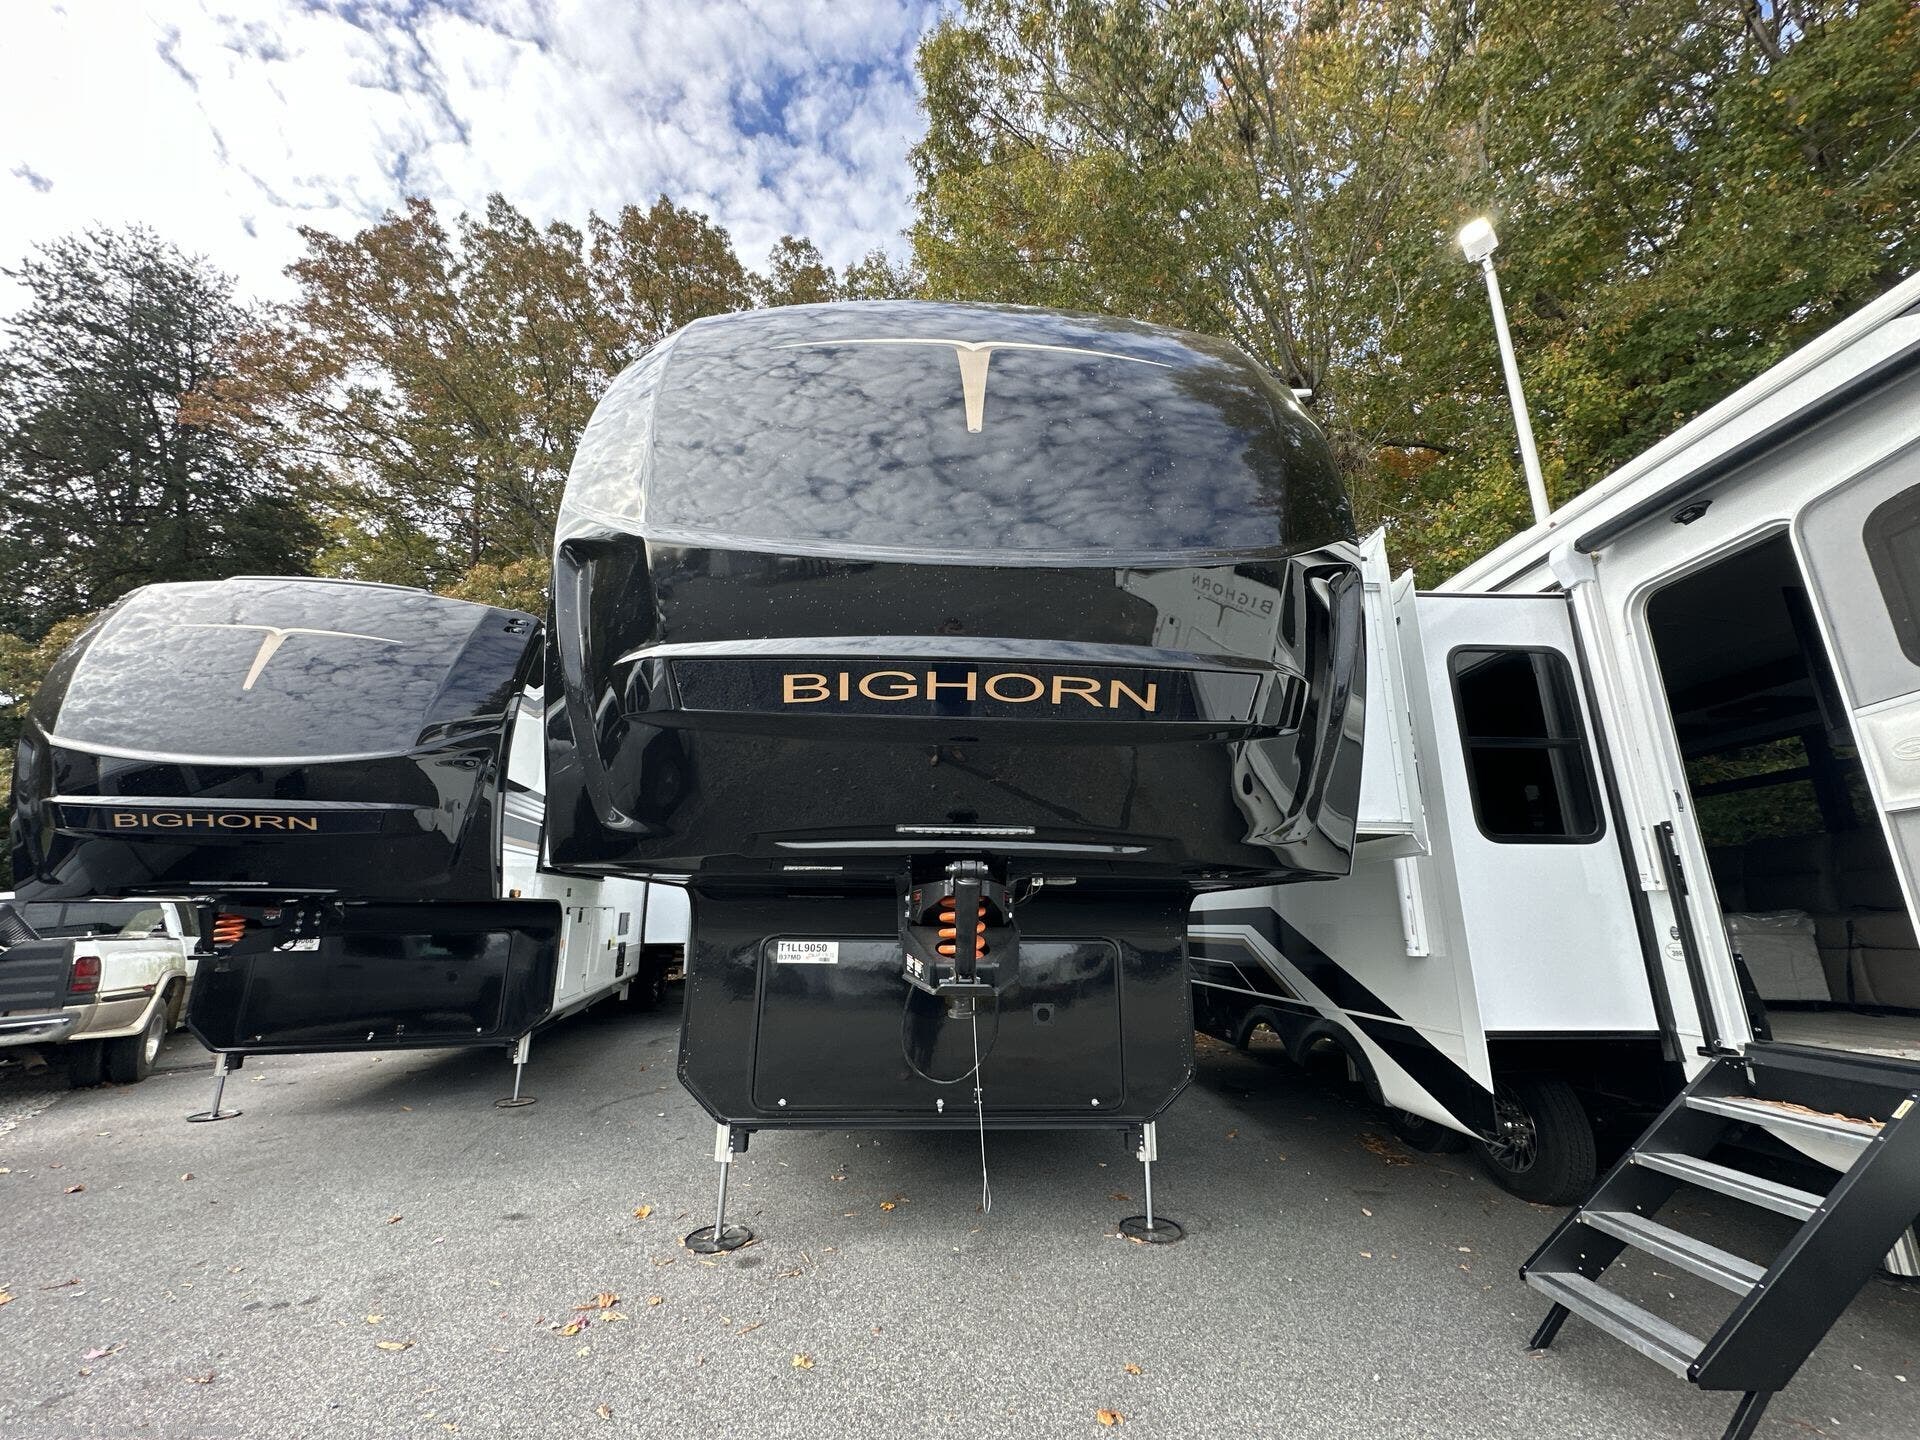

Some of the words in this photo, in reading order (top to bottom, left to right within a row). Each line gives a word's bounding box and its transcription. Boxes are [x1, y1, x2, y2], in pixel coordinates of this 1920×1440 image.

[783, 671, 1157, 712] BIGHORN
[113, 813, 318, 831] BIGHORN
[779, 943, 828, 952] T1LL9050
